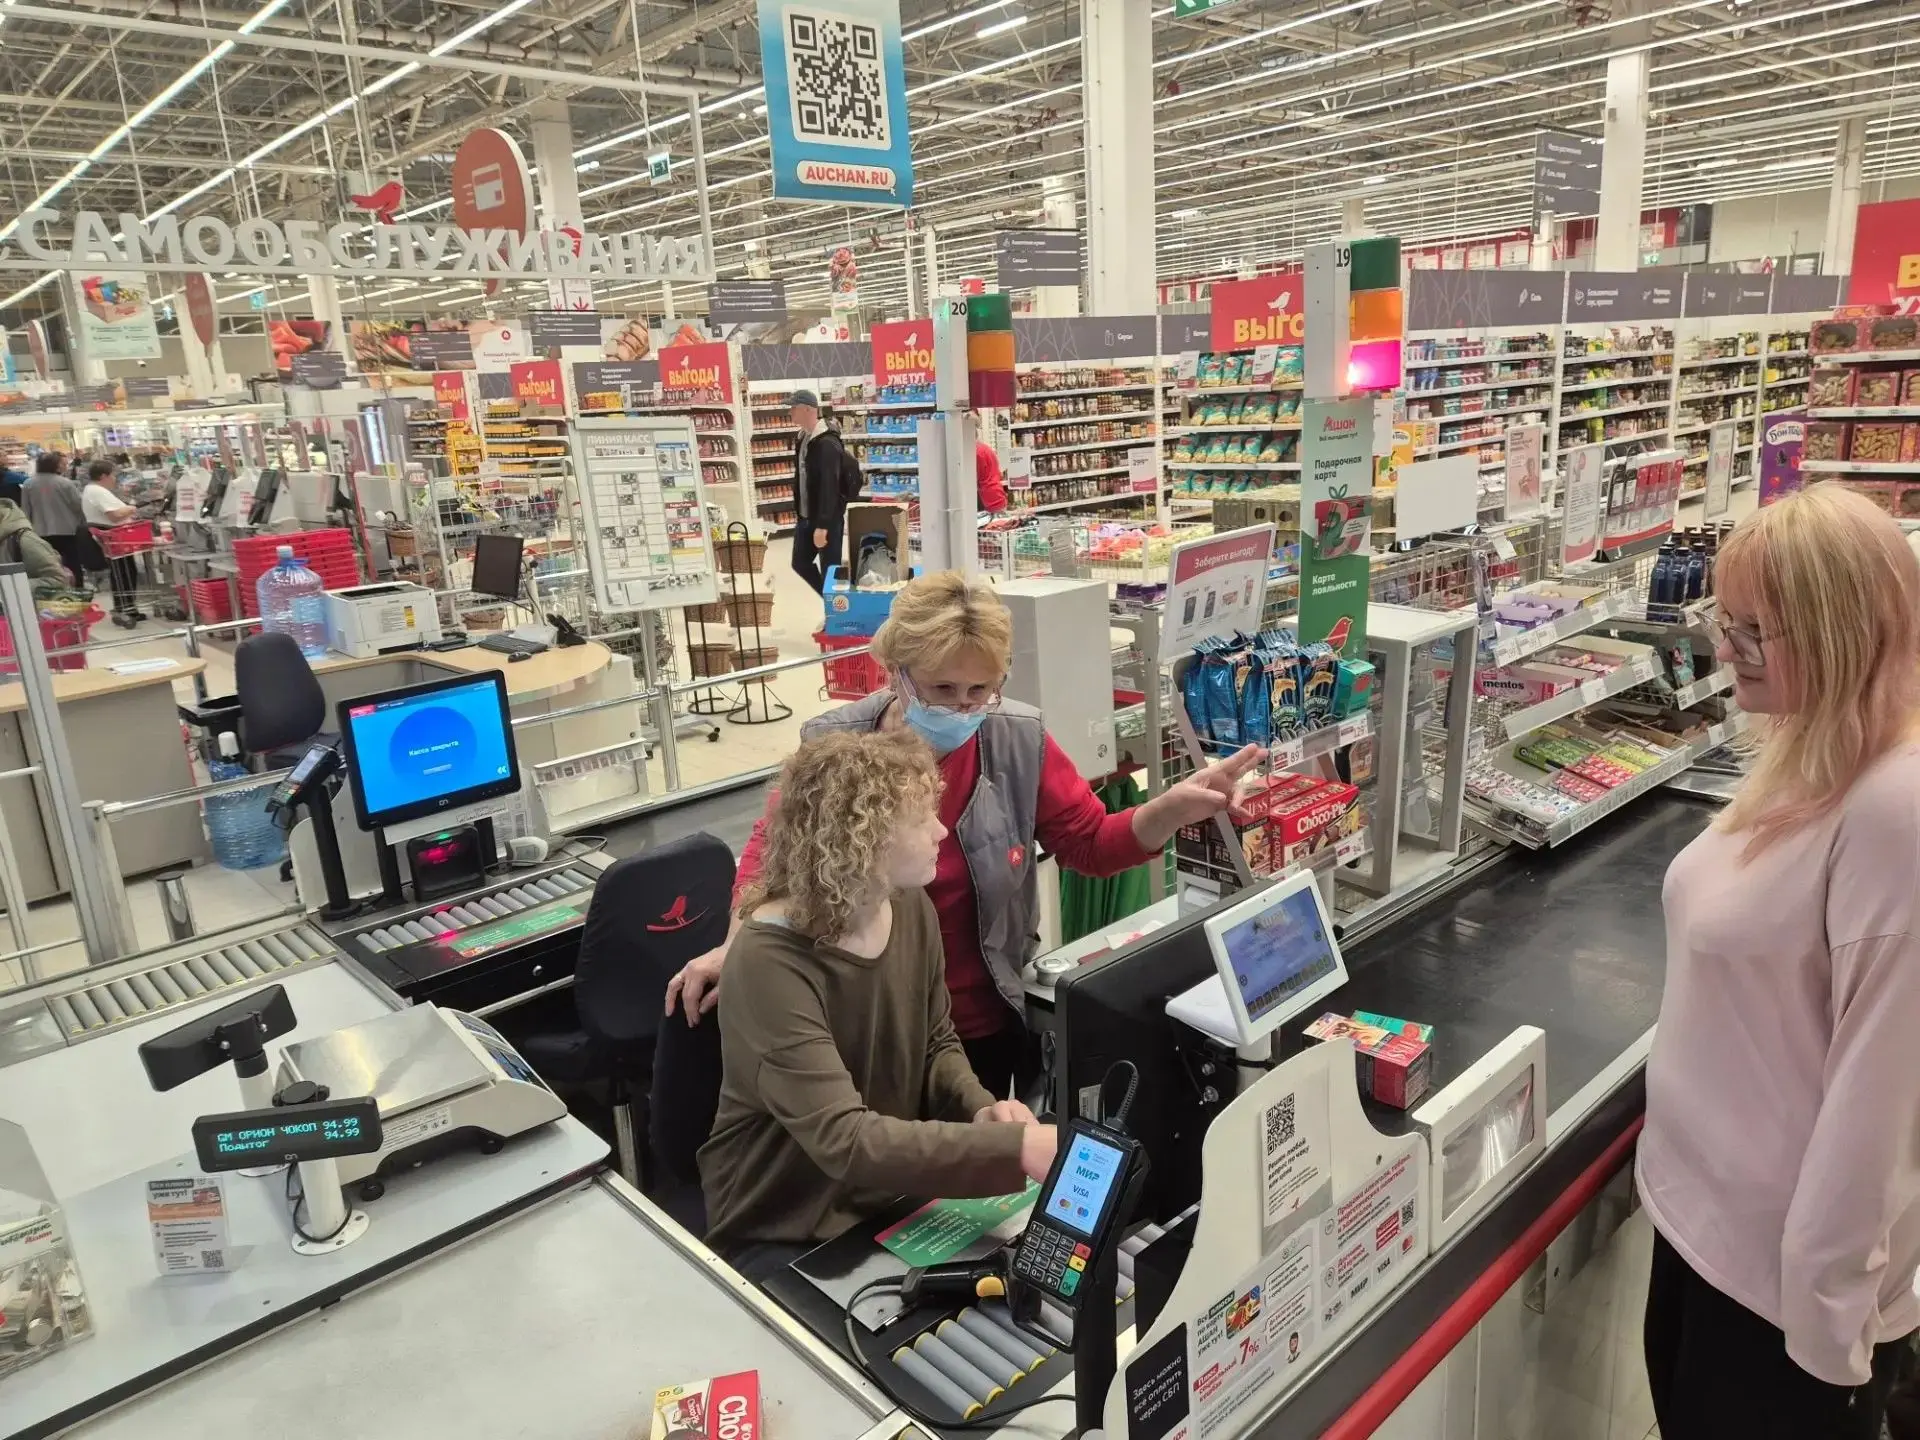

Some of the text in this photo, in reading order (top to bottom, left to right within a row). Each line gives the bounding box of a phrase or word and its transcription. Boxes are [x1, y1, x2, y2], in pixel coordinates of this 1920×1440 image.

[805, 165, 889, 186] AUCHAN.RU
[16, 208, 706, 276] САМООБСЛУЖИВАНИЯ
[1336, 248, 1351, 267] 19
[951, 302, 967, 316] 20
[1323, 416, 1356, 433] Ашан
[1314, 455, 1363, 471] Подарочная
[1314, 471, 1337, 482] карта
[1193, 551, 1229, 569] Заберите
[1311, 573, 1336, 586] Карта
[1311, 580, 1358, 597] лояльности
[1482, 678, 1526, 691] mentos
[322, 1117, 358, 1130] 94.99
[324, 1127, 360, 1140] 94.99
[1075, 1165, 1101, 1182] МИР
[1072, 1184, 1090, 1199] VISA
[1239, 1336, 1261, 1366] 7%
[1133, 1355, 1183, 1401] Здесь можно
[1147, 1369, 1184, 1401] оплатить
[1138, 1381, 1181, 1421] через СБП
